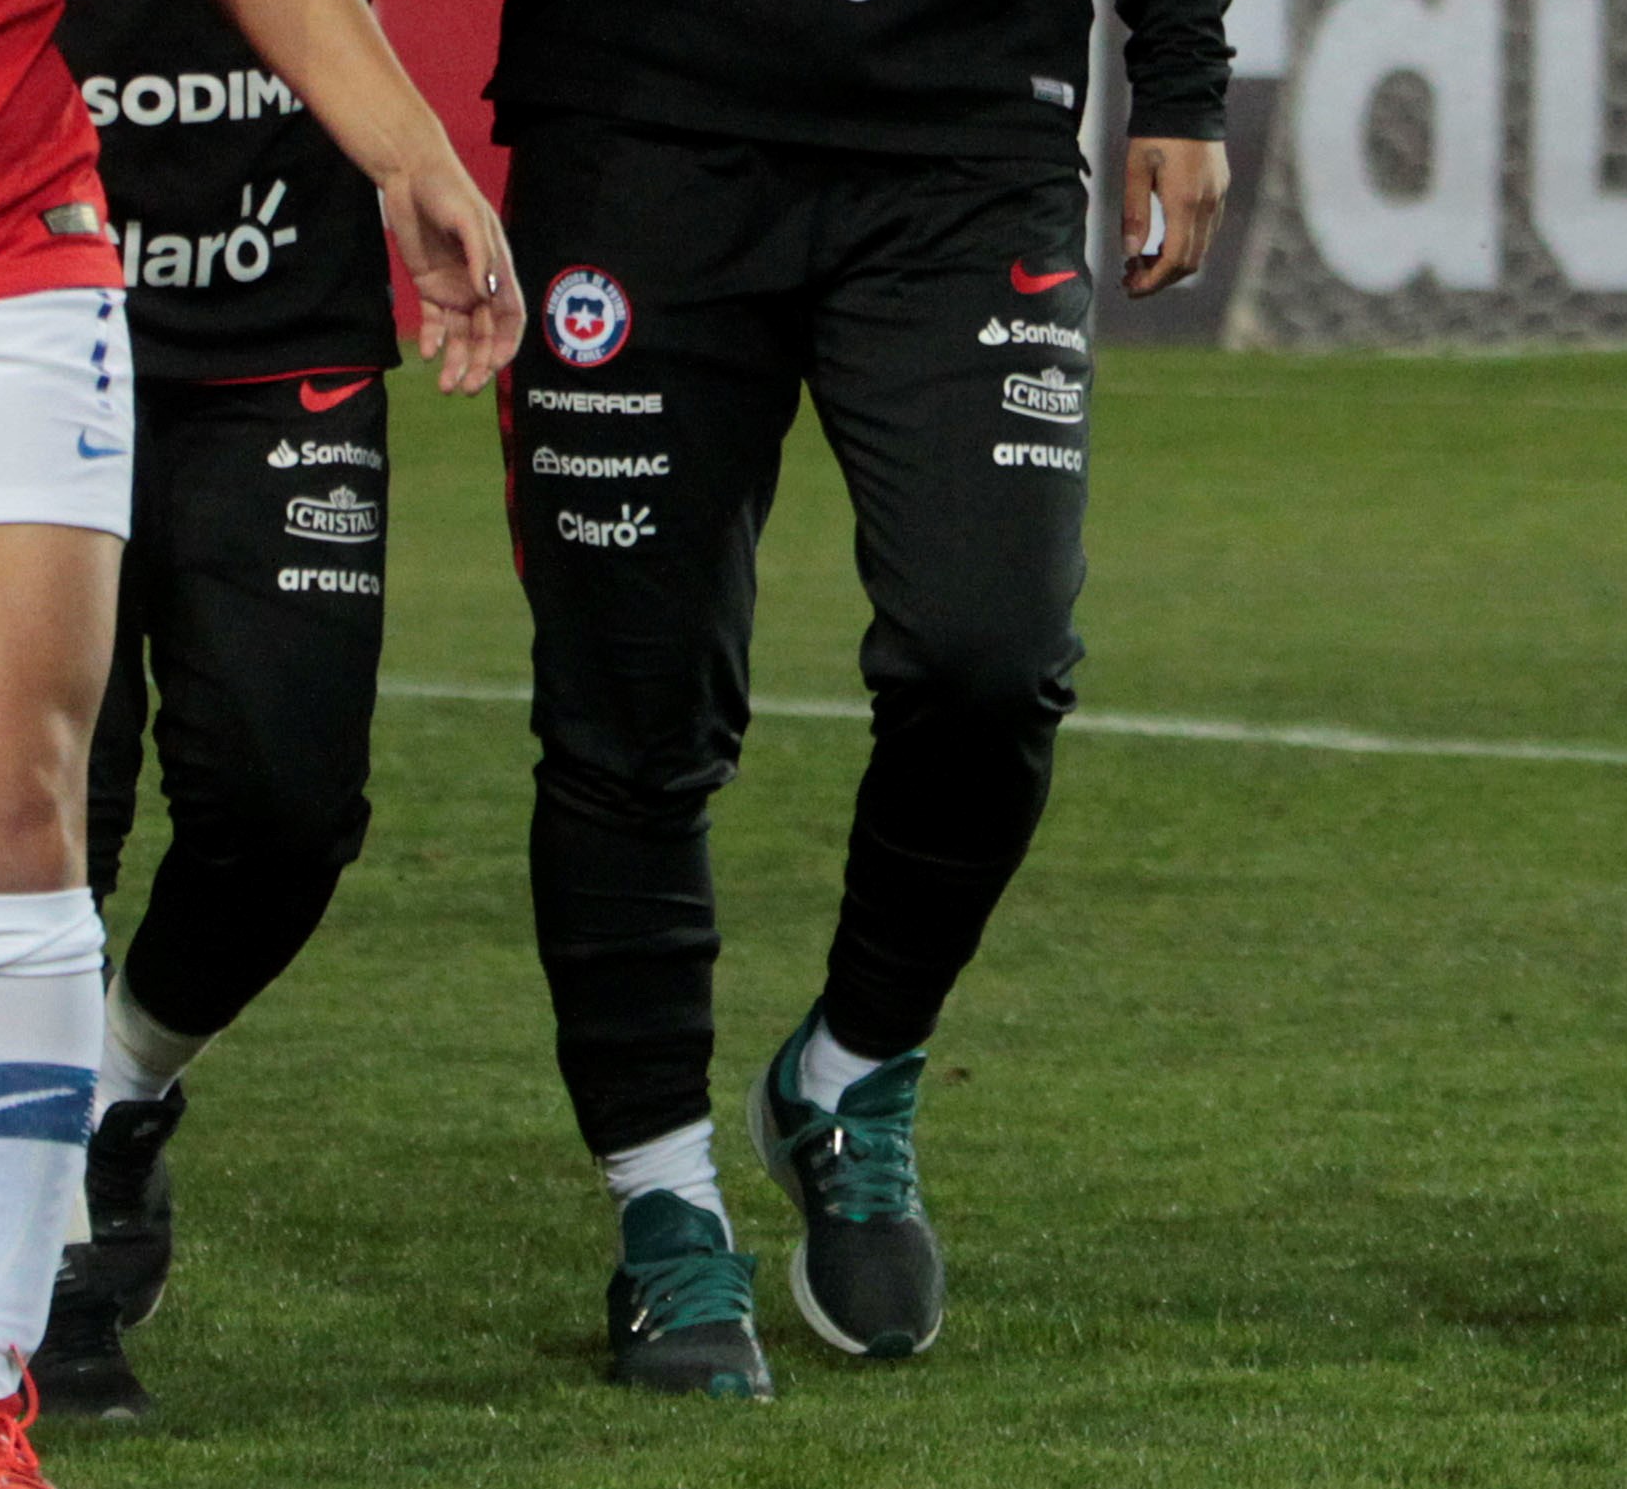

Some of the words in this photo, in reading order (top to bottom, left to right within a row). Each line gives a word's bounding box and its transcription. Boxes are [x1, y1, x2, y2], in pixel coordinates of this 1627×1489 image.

[81, 69, 303, 127] SODIM
[107, 202, 274, 287] laro
[528, 389, 663, 414] POWERADE
[561, 455, 670, 478] SODIMAC
[992, 442, 1083, 473] arauco
[296, 506, 375, 534] CRISTAL
[557, 509, 638, 548] Claro
[277, 567, 381, 596] arauco
